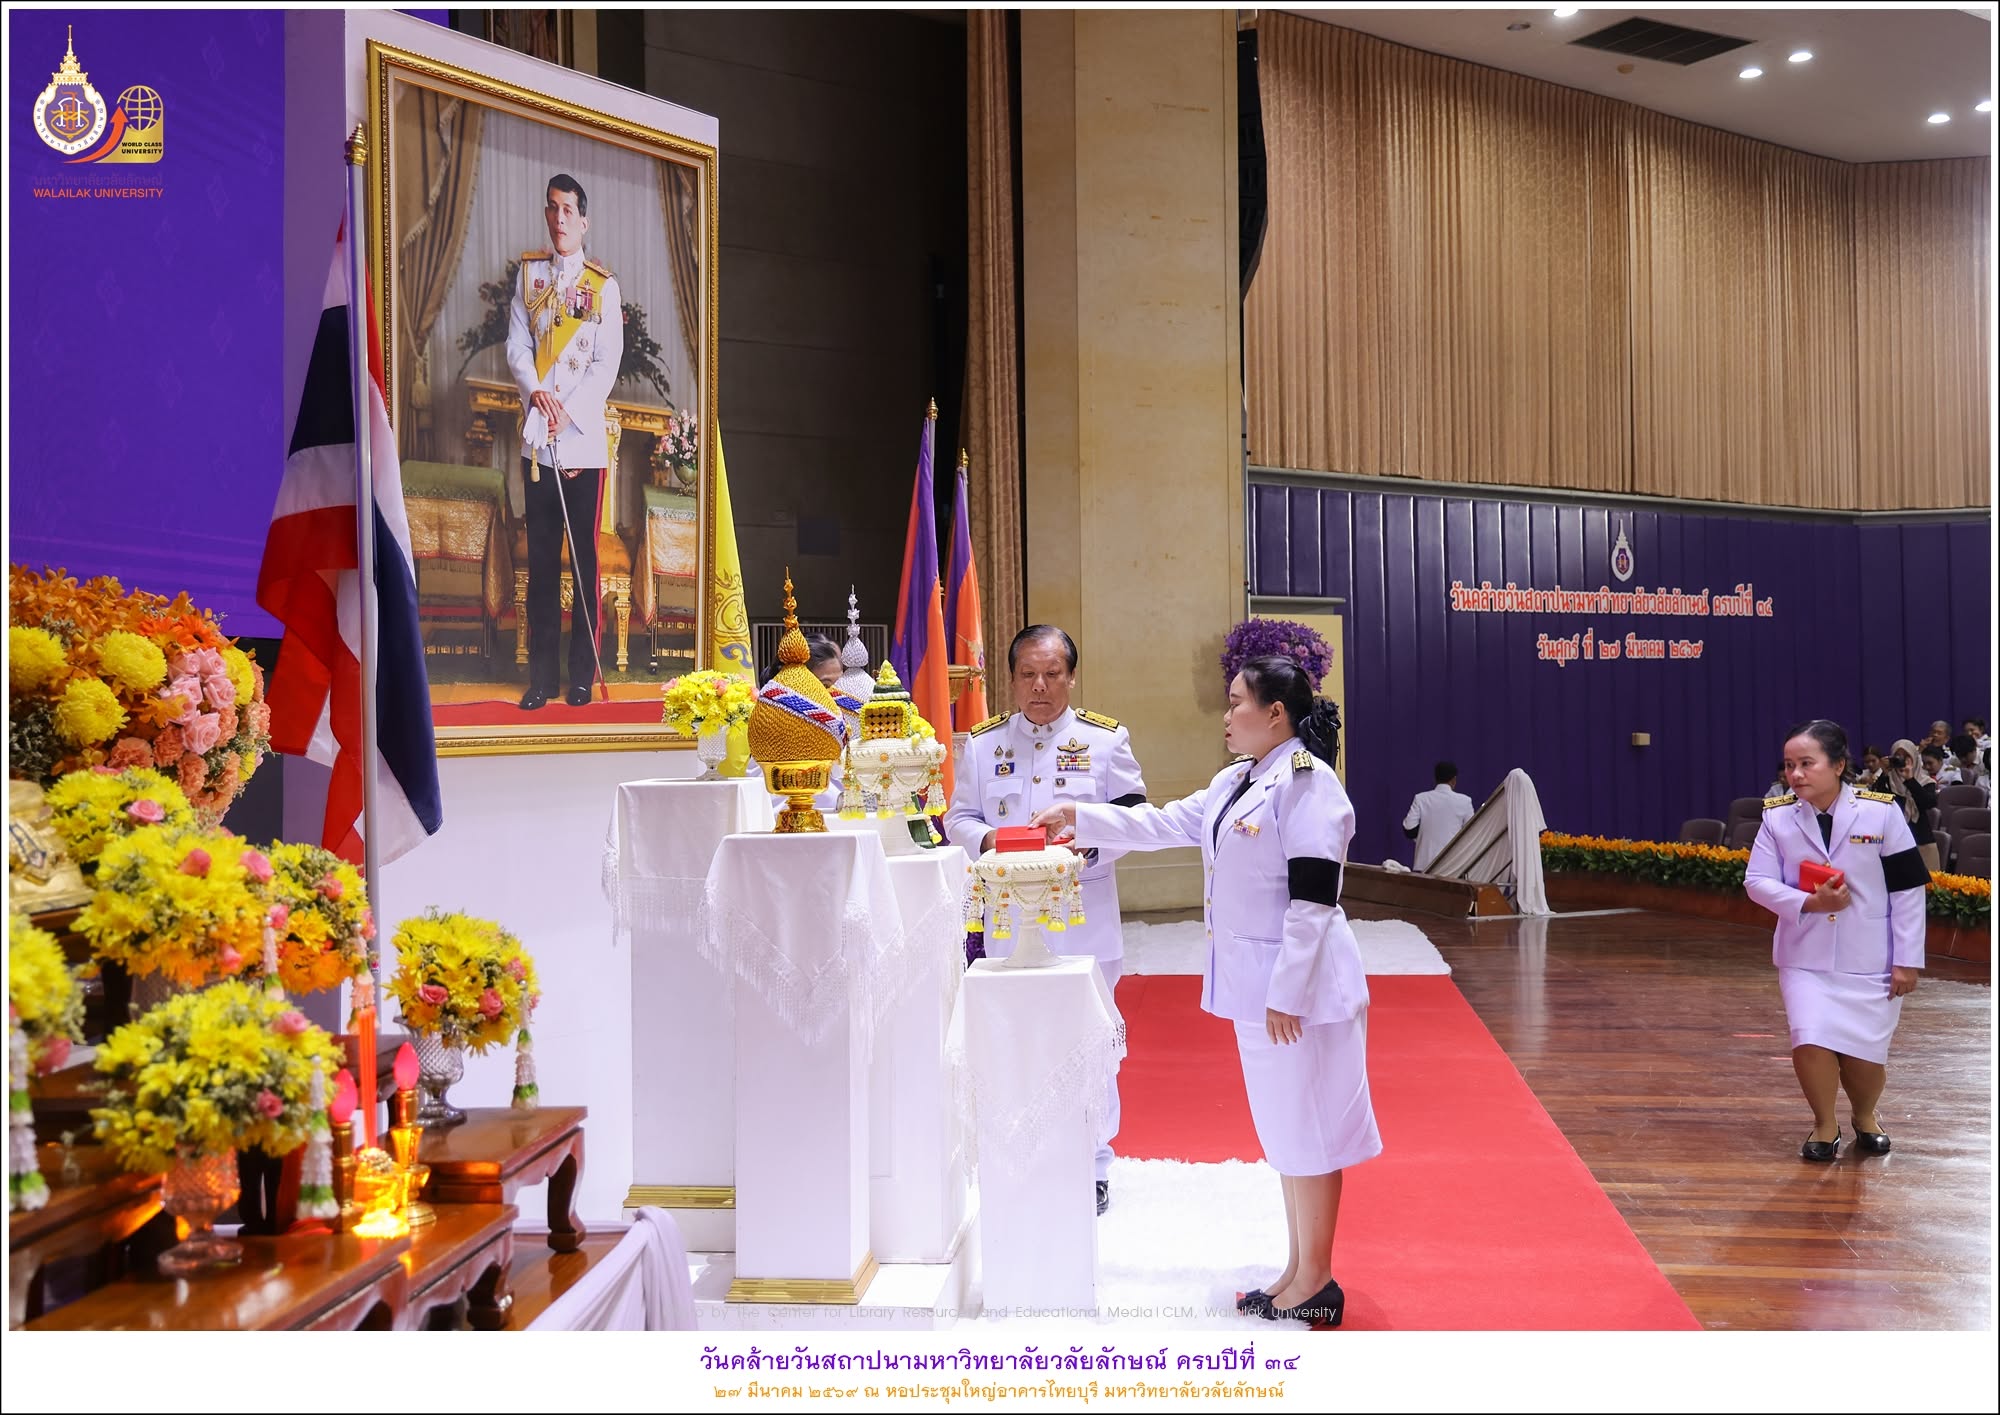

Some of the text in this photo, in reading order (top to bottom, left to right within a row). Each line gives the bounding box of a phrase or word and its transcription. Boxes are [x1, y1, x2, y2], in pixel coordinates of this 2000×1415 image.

[1713, 583, 1753, 616] ครบปีที่
[1537, 633, 1580, 667] วันศุกร์
[1583, 628, 1593, 659] ที่
[1626, 632, 1665, 658] มีนาคม
